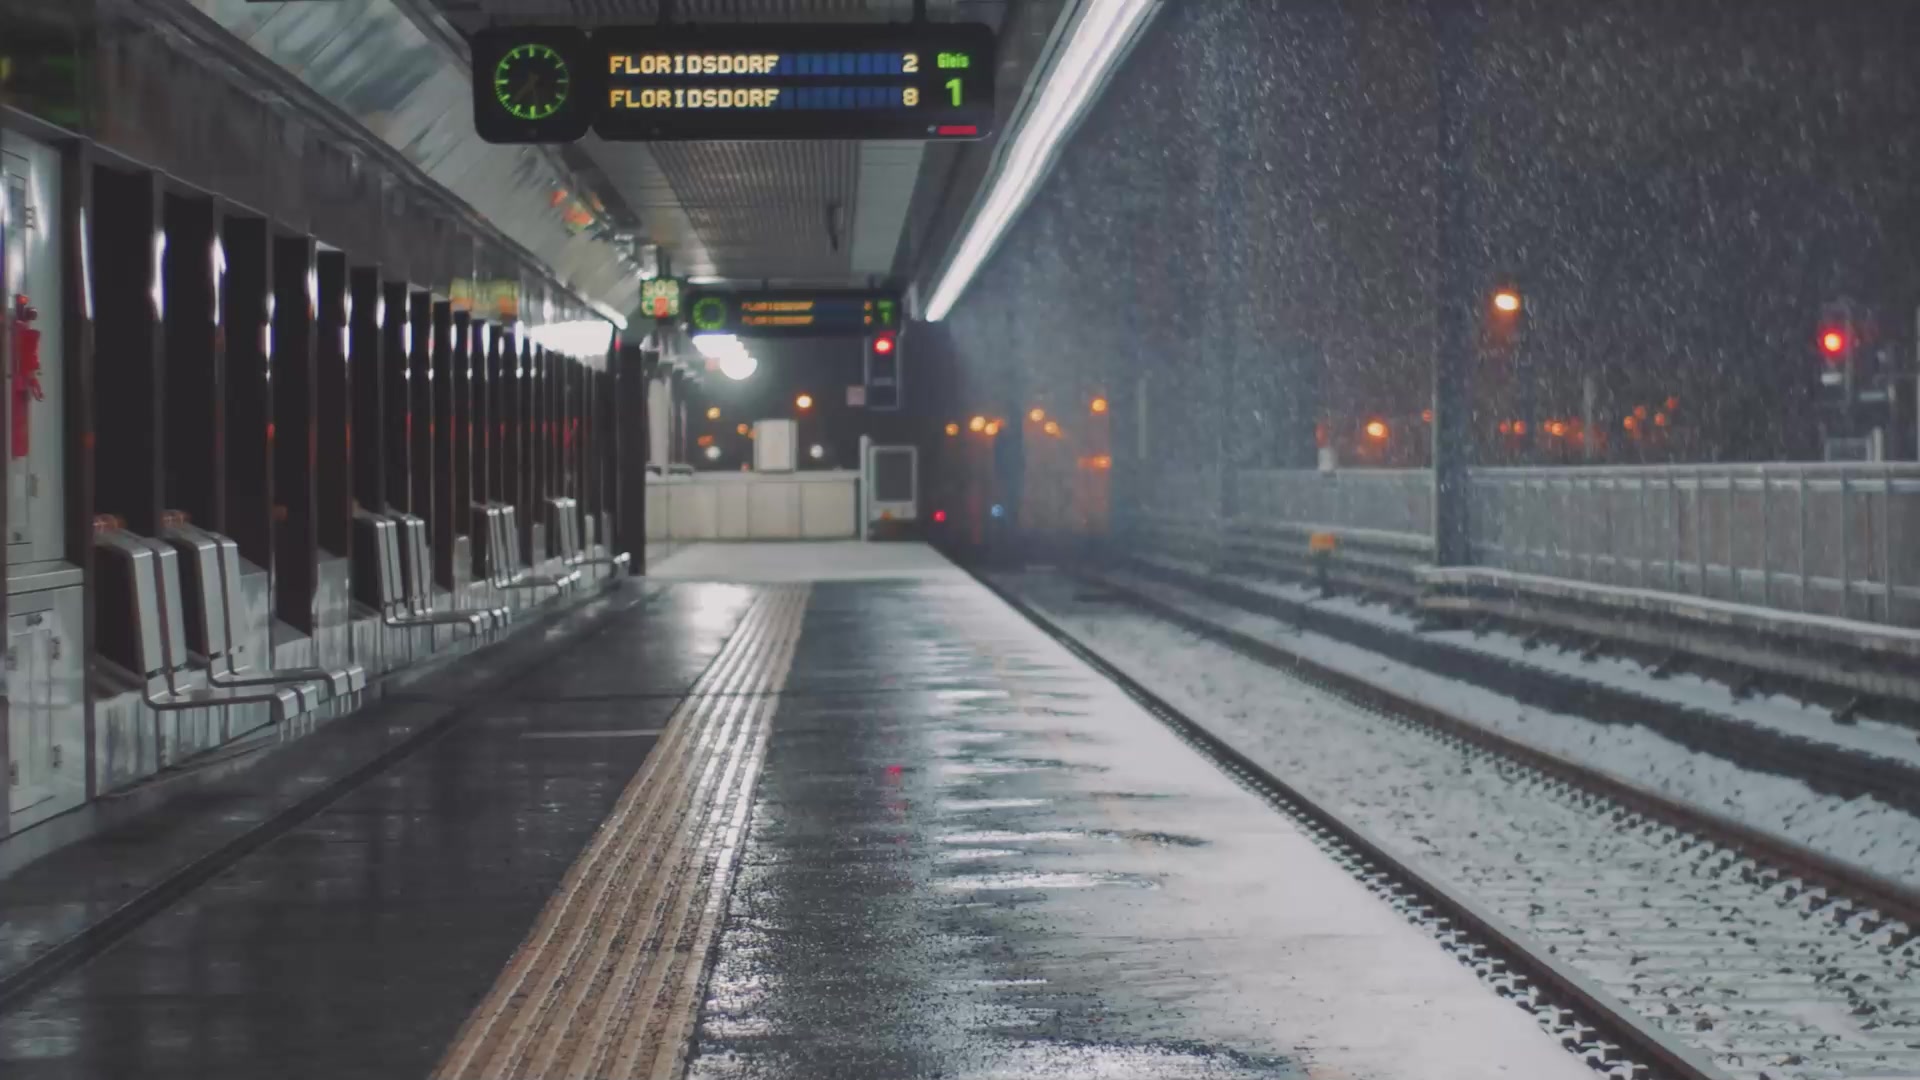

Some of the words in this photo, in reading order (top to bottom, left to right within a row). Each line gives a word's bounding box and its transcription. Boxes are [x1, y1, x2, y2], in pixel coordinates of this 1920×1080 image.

[609, 54, 780, 74] FLORIDSDORF
[902, 54, 919, 73] 2
[937, 52, 970, 69] Gleis
[609, 89, 780, 108] FLORIDSDORF
[902, 87, 919, 107] 8
[945, 78, 962, 107] 1
